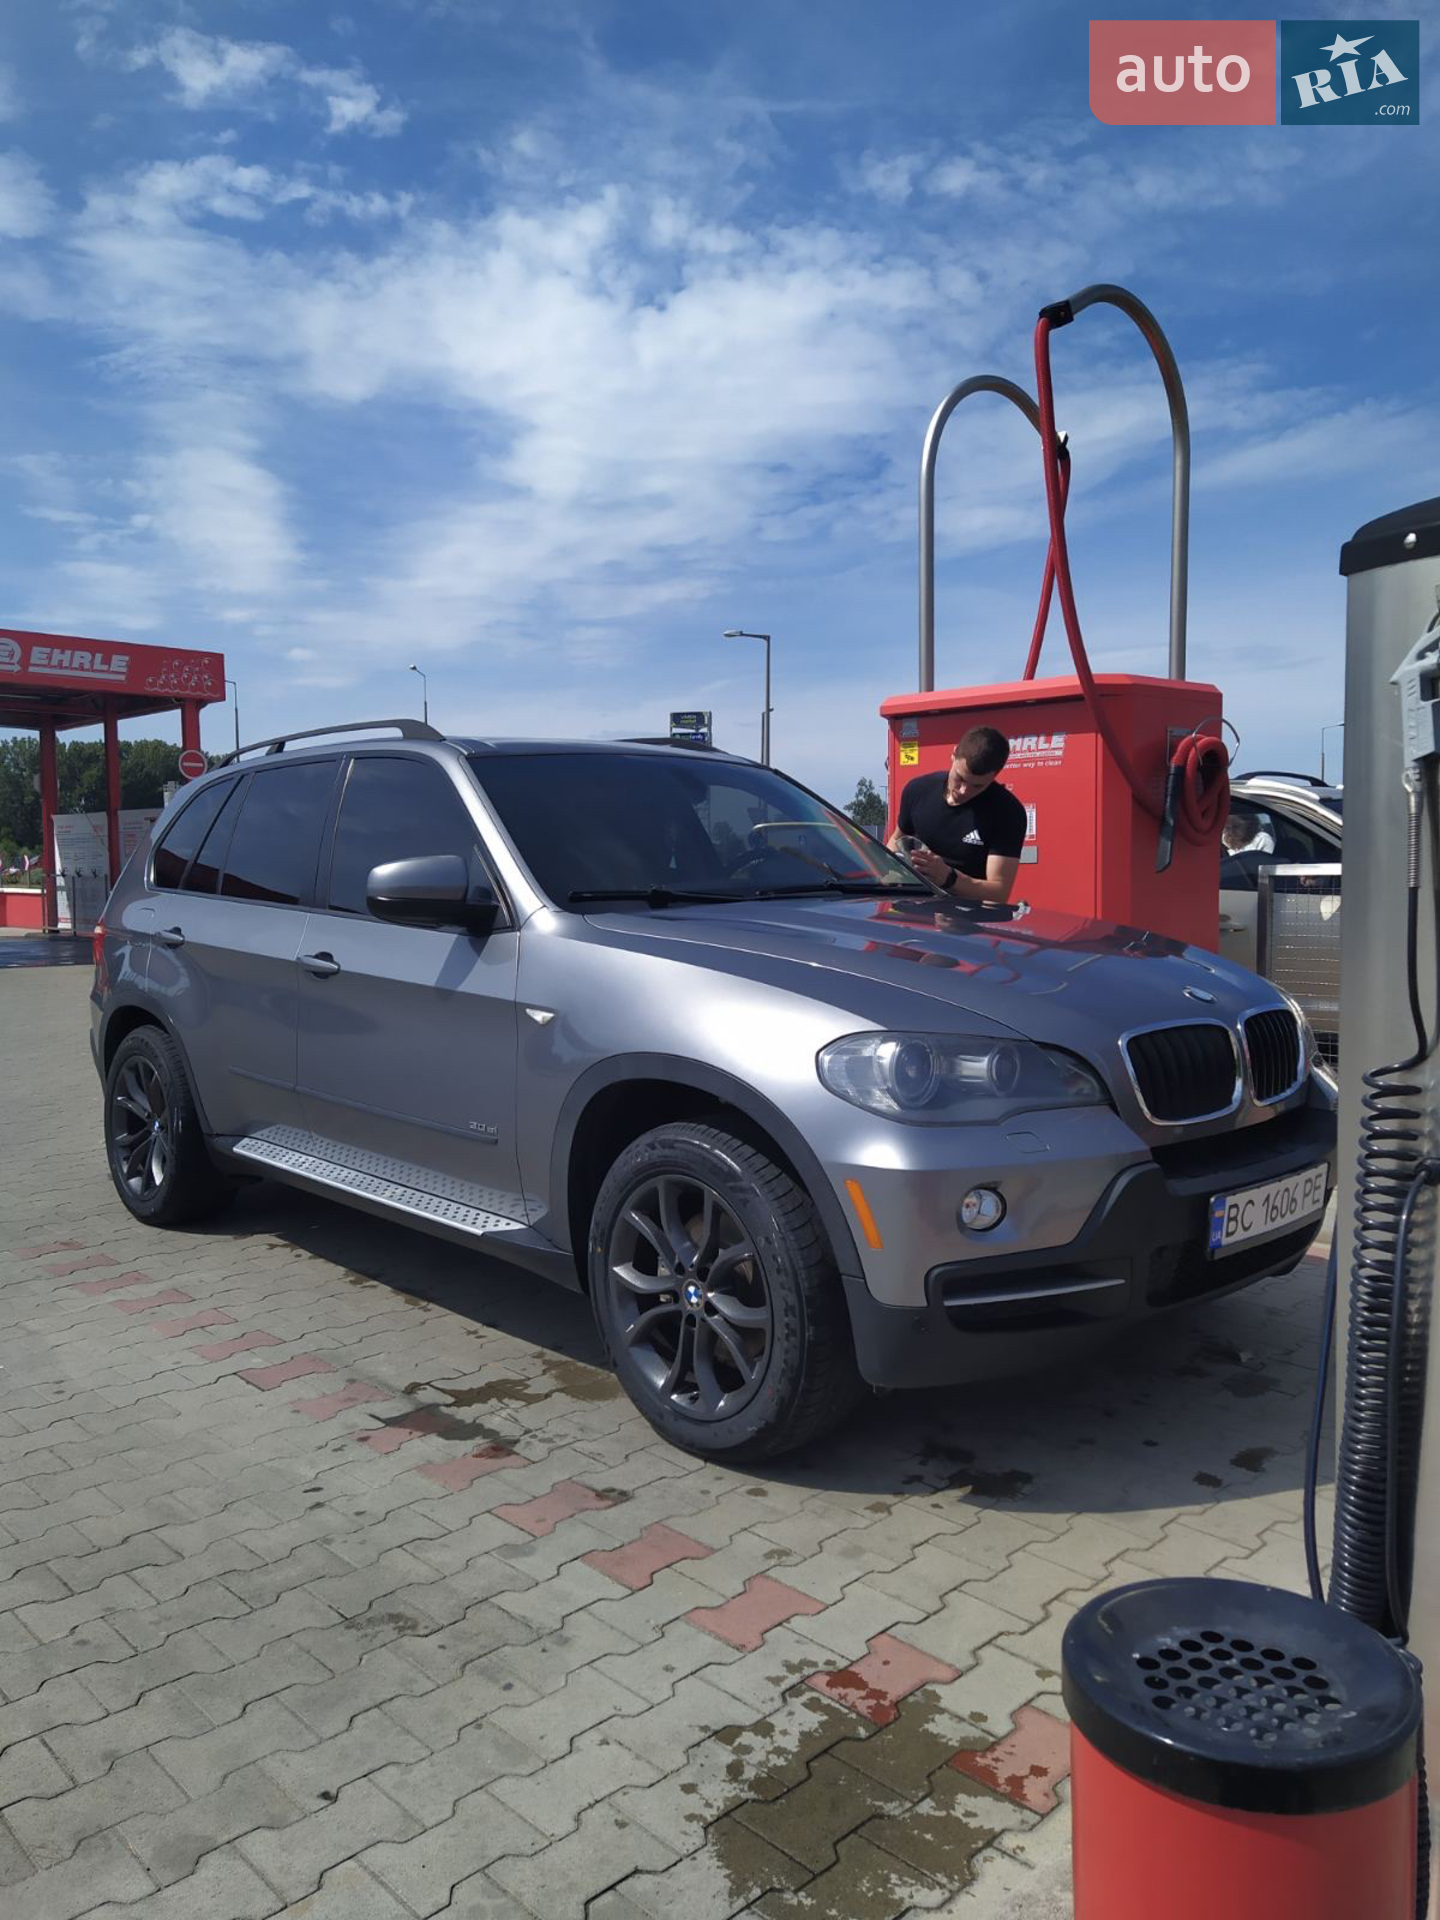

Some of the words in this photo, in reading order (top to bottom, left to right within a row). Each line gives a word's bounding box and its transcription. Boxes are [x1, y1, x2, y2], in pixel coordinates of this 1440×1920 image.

[29, 646, 129, 673] EHRLE
[1008, 732, 1066, 751] HRLE
[1225, 1200, 1255, 1238] BC
[1262, 1183, 1299, 1225] 1606
[1302, 1173, 1322, 1210] PE
